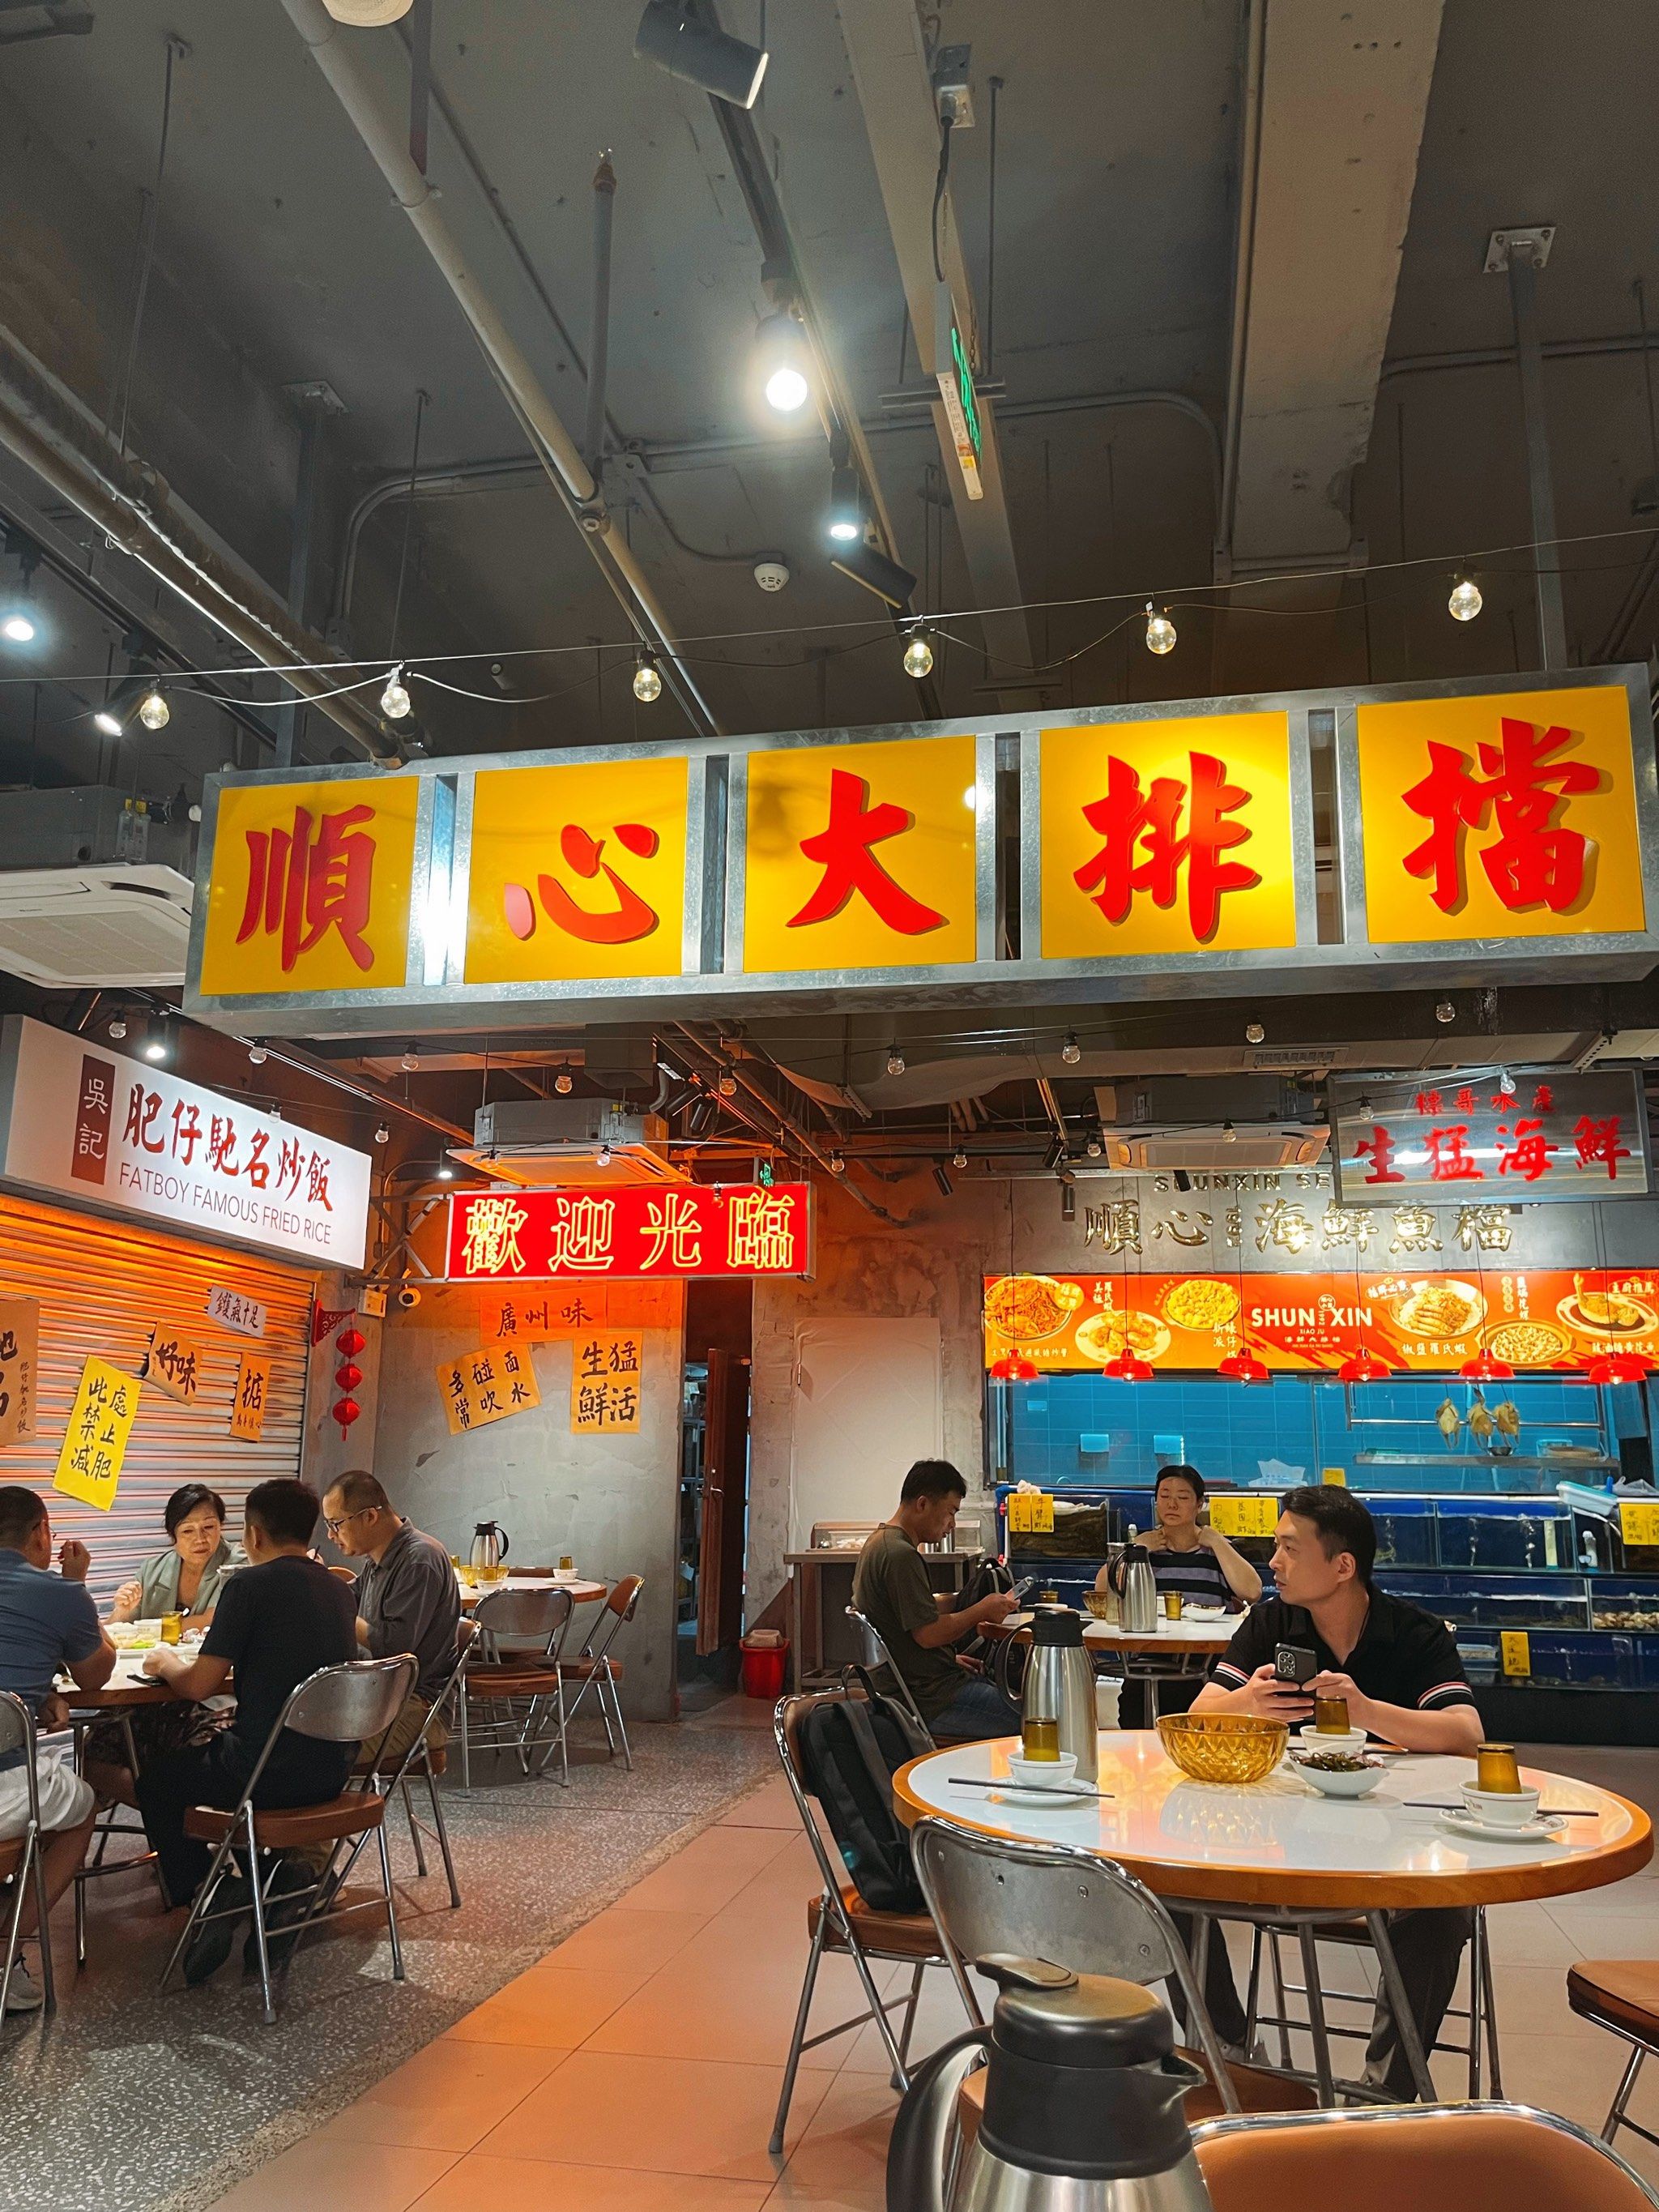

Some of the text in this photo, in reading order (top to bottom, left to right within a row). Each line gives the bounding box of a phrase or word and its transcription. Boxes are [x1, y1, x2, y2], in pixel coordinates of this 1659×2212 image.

[235, 716, 1602, 973] 順心大排擋
[79, 1078, 109, 1159] 吳記
[122, 1083, 334, 1212] 肥仔馳名炒飯
[1352, 1115, 1631, 1184] 生猛海鮮
[119, 1162, 331, 1245] FATBOY FAMOUS FRIED RICE
[461, 1193, 795, 1275] 歡迎光臨
[496, 1297, 595, 1338] 廣州味
[1251, 1307, 1316, 1327] SHUN
[1330, 1306, 1373, 1327] XIN
[581, 1340, 639, 1380] 生猛
[88, 1376, 128, 1418] 此處
[454, 1381, 531, 1429] 常吹水
[578, 1381, 638, 1427] 鮮活
[80, 1402, 116, 1446] 禁止
